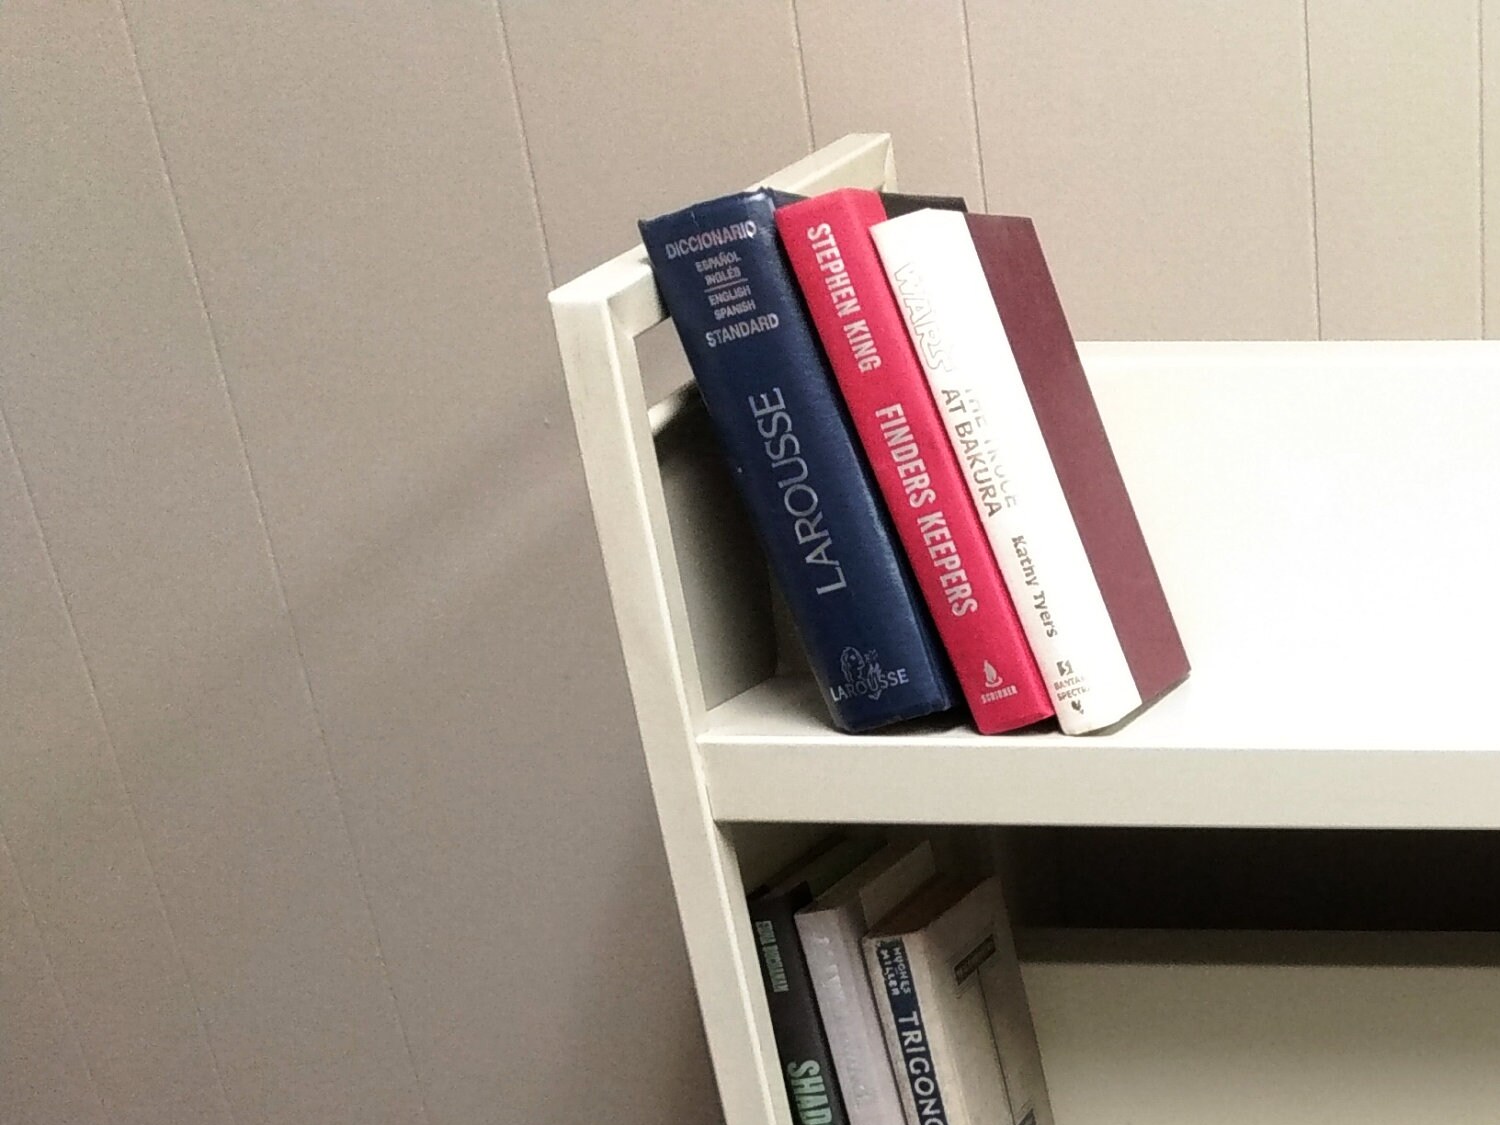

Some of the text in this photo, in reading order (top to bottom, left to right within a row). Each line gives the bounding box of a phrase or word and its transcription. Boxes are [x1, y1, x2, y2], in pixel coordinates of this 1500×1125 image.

[665, 220, 757, 259] DICCIONARIO
[694, 251, 742, 273] ESPAÑOL
[708, 285, 751, 306] ENGLISH
[714, 299, 756, 320] SPANISH
[807, 223, 882, 373] STEPHEN KING
[705, 312, 779, 348] STANDARD
[941, 389, 1002, 518] AT BAKURA
[748, 386, 848, 596] LAROUSSE
[875, 403, 978, 617] FINDERS KEEPERS
[1011, 535, 1058, 638] Kathy Tyers
[830, 668, 909, 701] LAROUSSE
